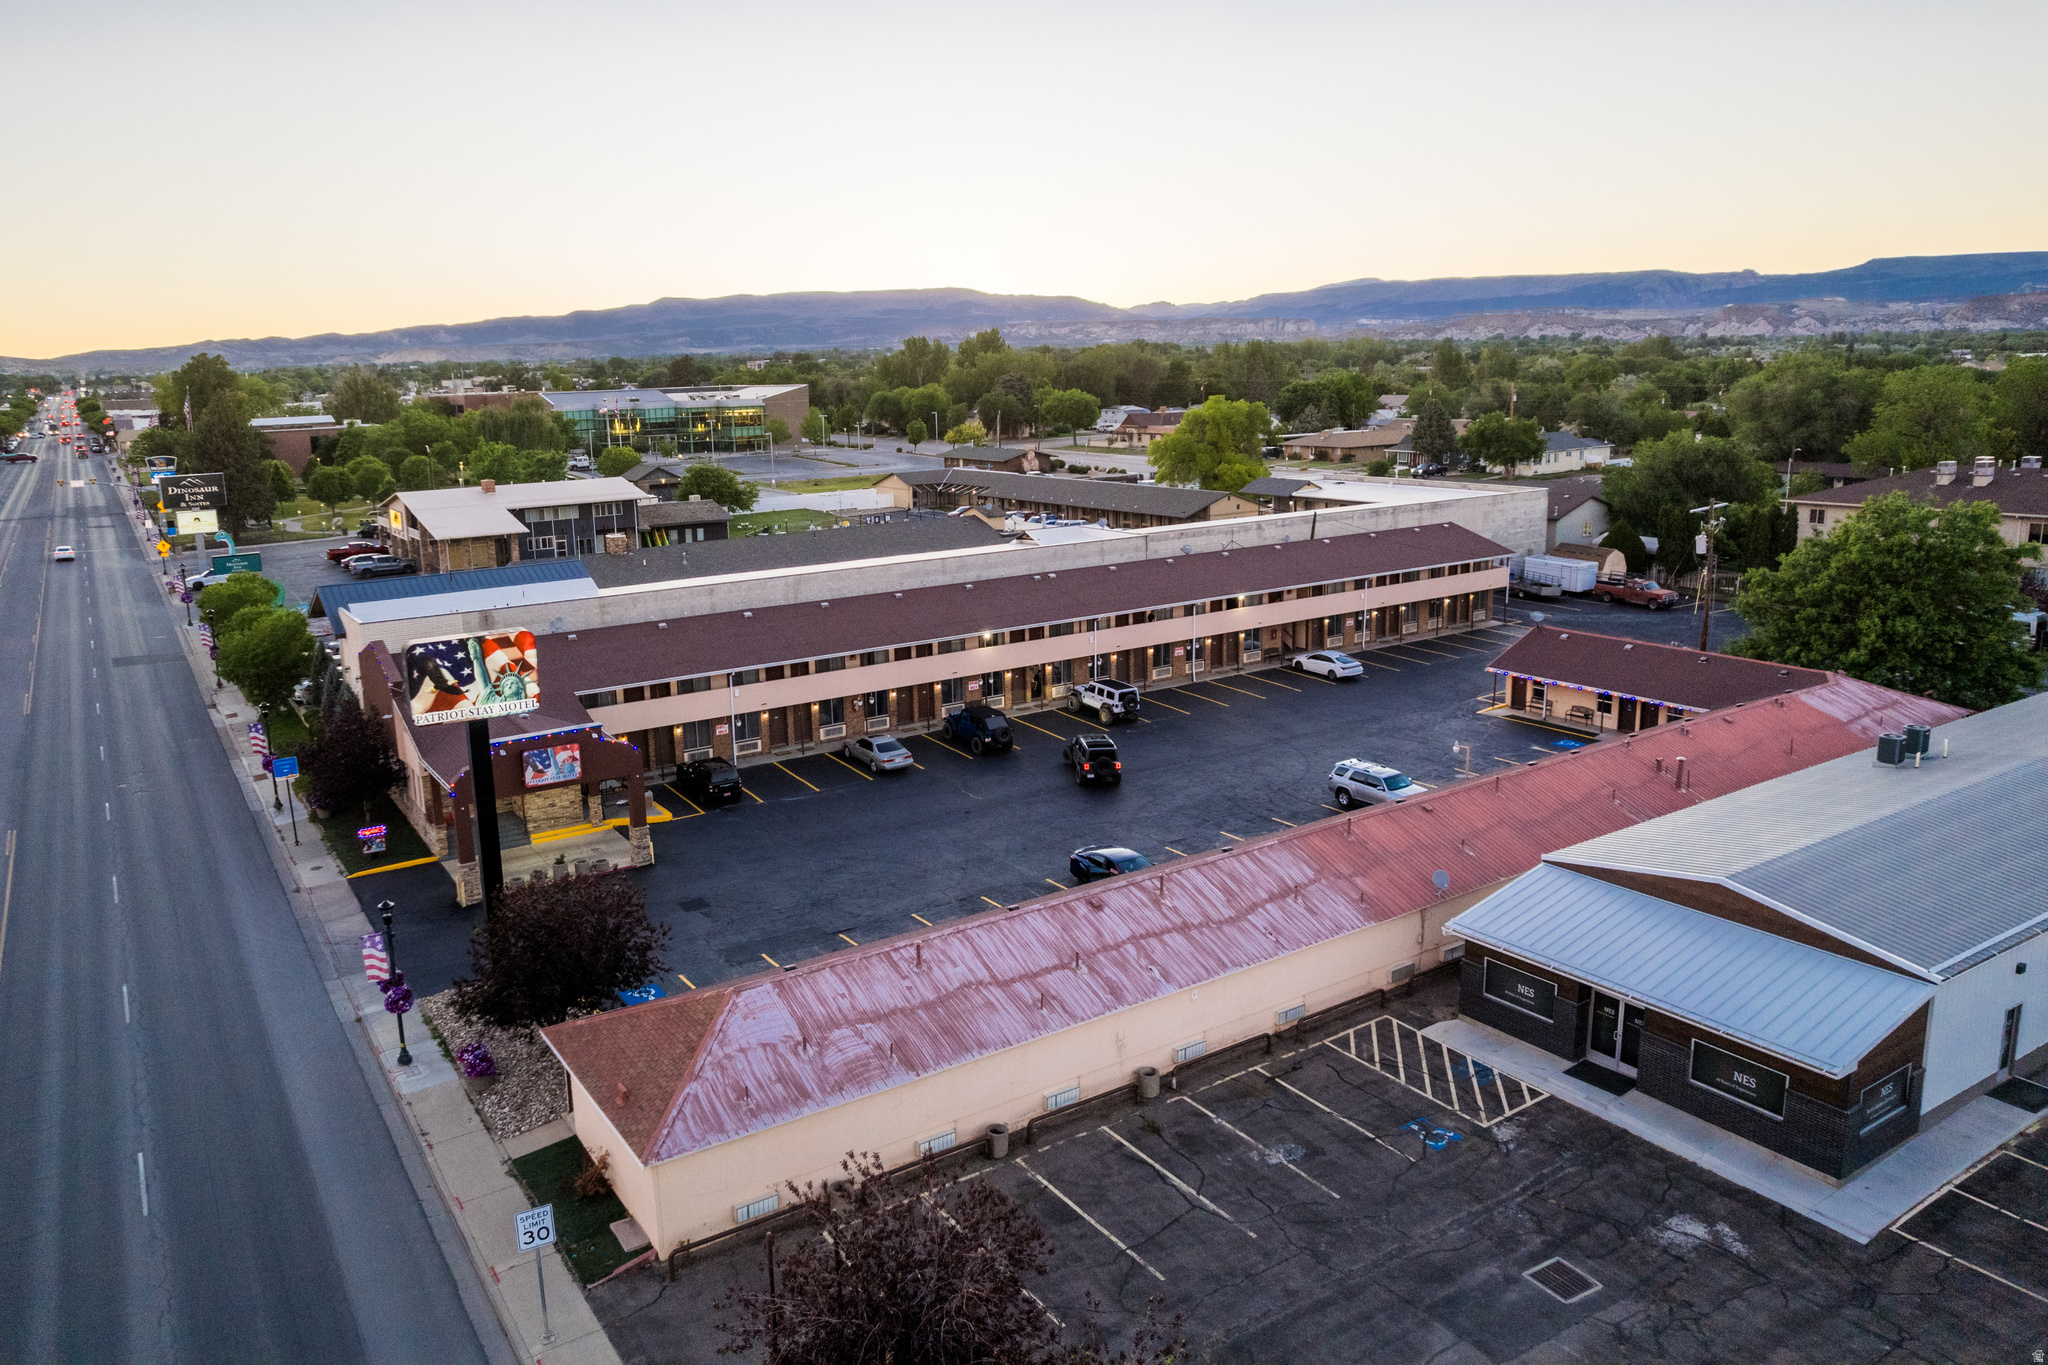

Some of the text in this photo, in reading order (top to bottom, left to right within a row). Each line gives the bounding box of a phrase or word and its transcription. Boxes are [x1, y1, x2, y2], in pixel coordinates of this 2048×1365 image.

[168, 485, 219, 495] DINOSAUR
[185, 493, 204, 501] INN
[416, 699, 538, 725] PATRIOT STAY MOTEL
[1517, 983, 1535, 998] NES
[1604, 1006, 1615, 1015] NES
[1733, 1070, 1757, 1089] NES
[1880, 1082, 1893, 1098] NES
[519, 1210, 549, 1223] SPEED
[523, 1218, 546, 1230] LIMIT
[523, 1226, 550, 1245] 30
